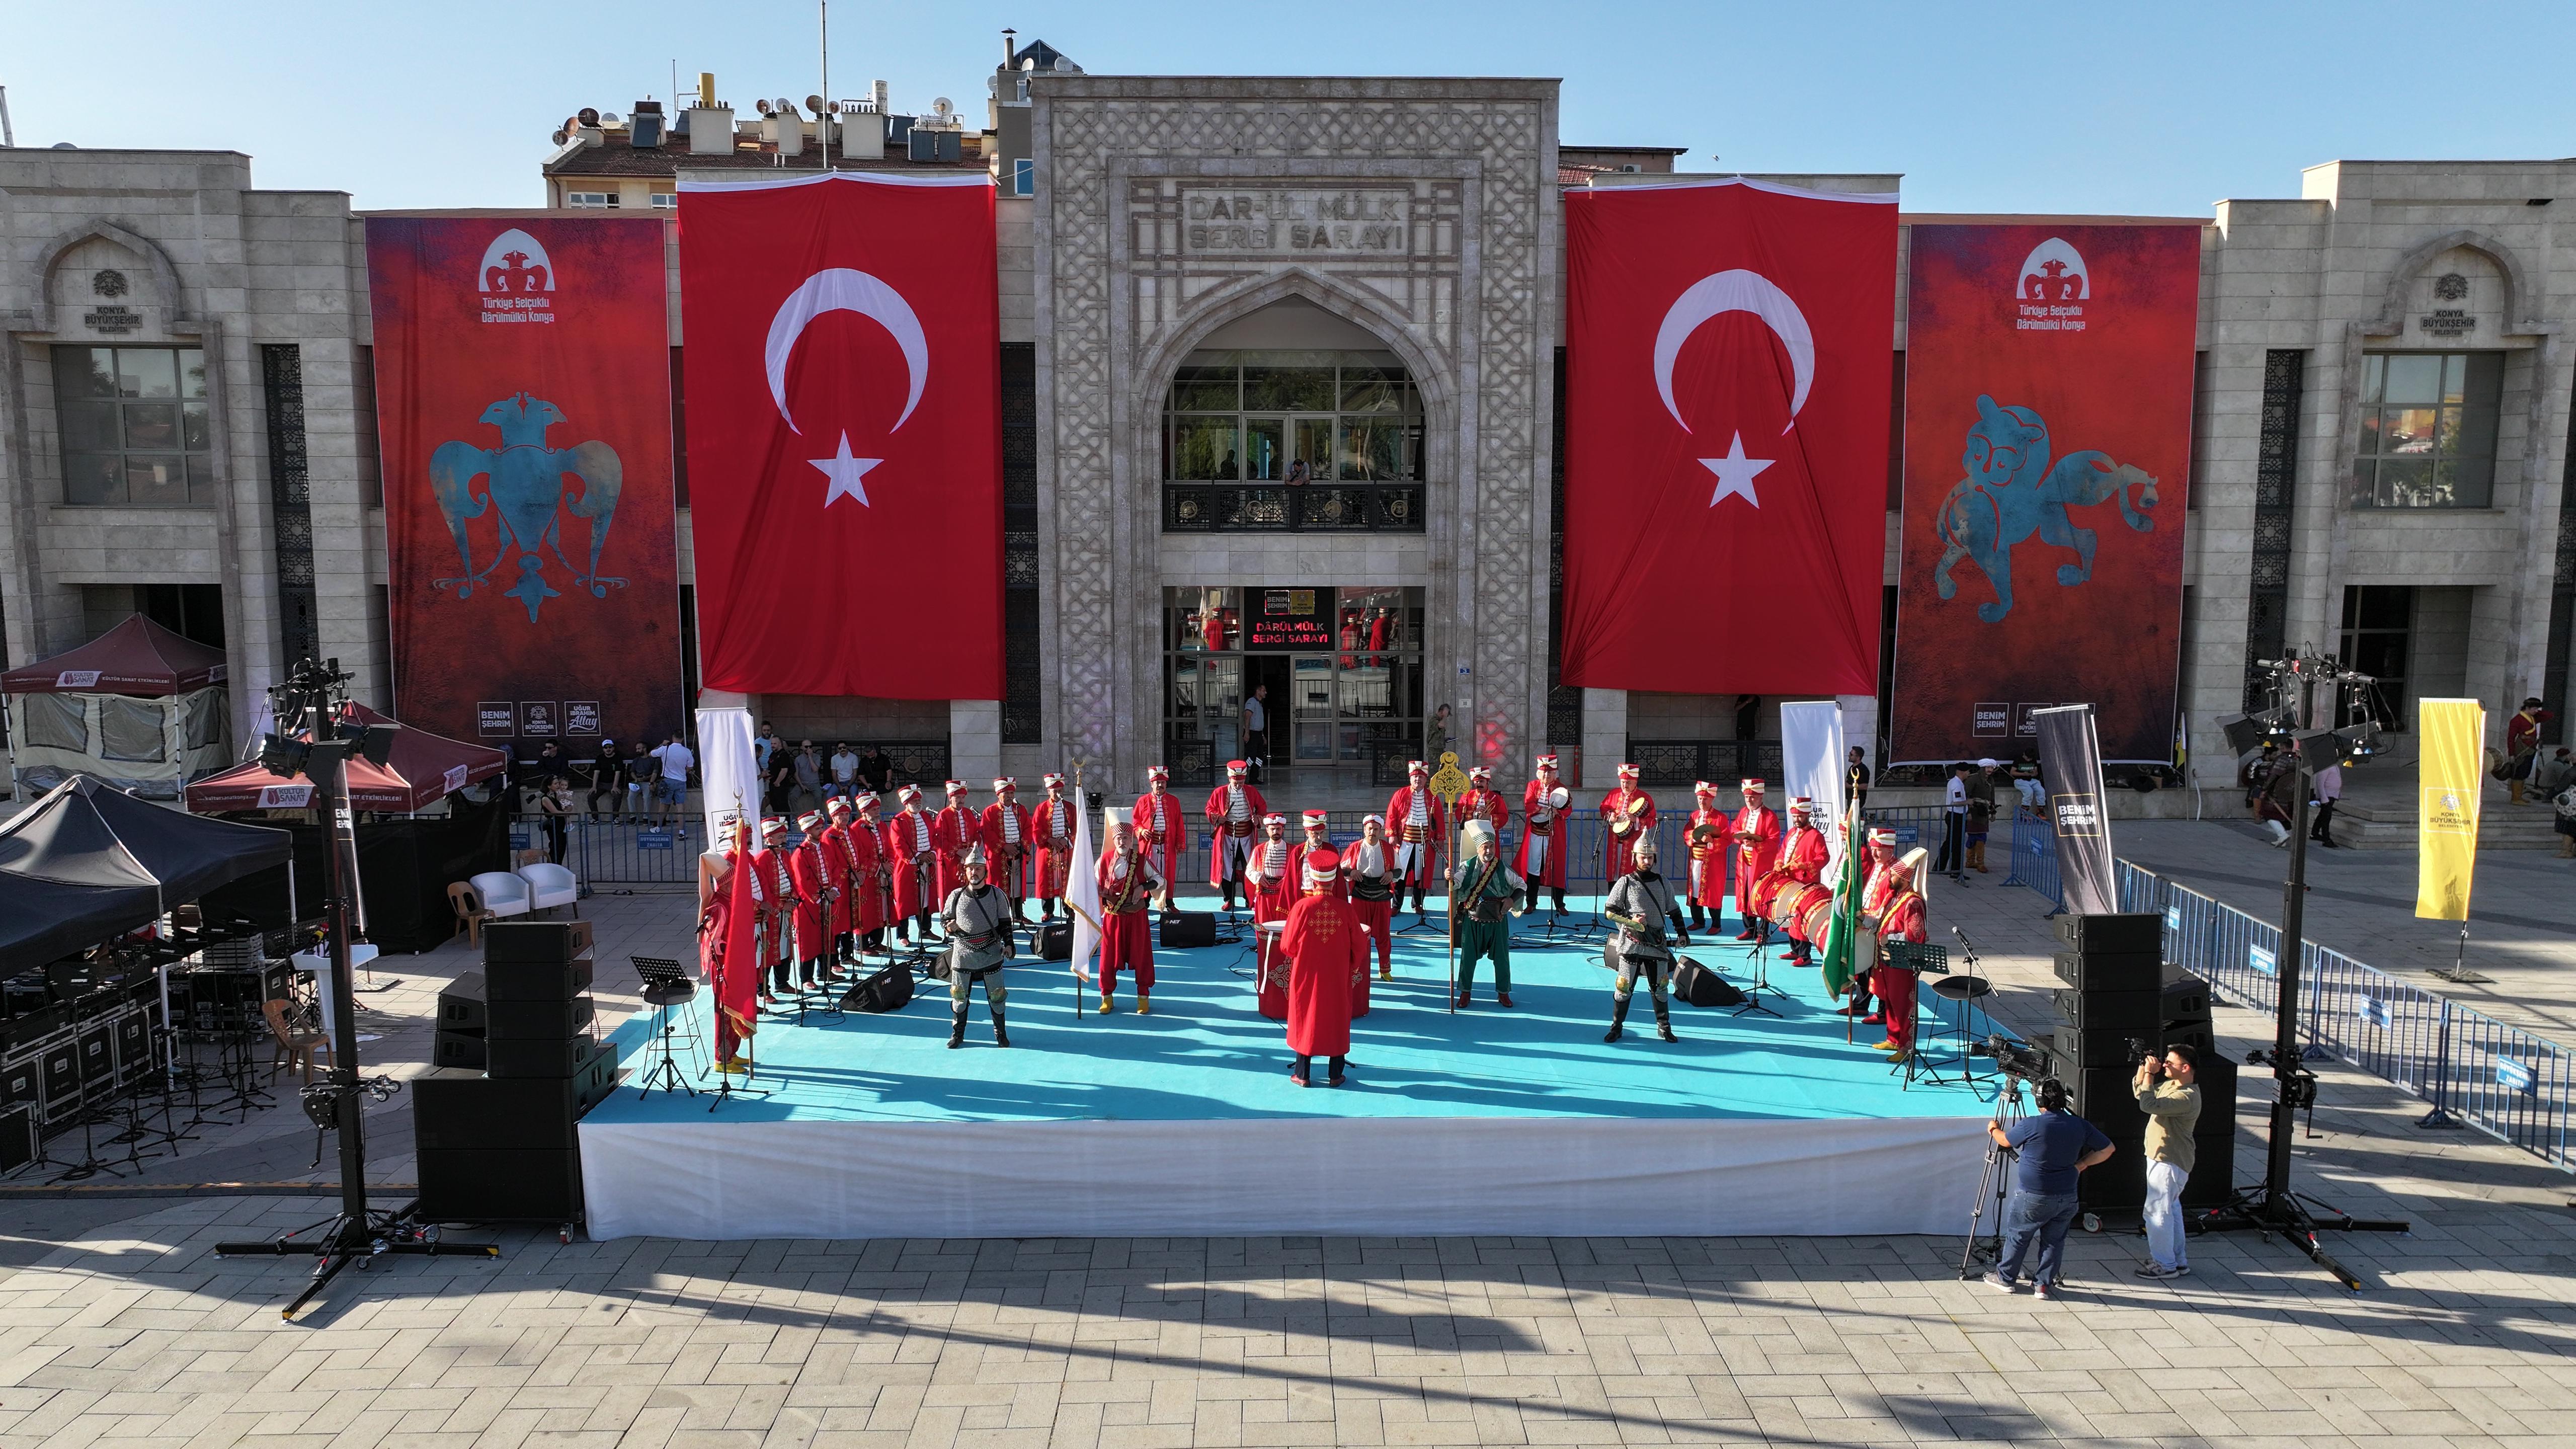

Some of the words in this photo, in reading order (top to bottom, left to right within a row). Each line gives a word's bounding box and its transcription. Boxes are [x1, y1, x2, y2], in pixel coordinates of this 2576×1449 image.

[1318, 194, 1401, 220] MÜLK
[1190, 222, 1276, 249] SERGİ
[1292, 225, 1403, 249] SARAYI
[482, 297, 513, 310] Türkiye
[515, 297, 549, 310] Selçuklu
[2020, 304, 2048, 317] Türkiye
[2050, 305, 2082, 318] Selçuklu
[85, 314, 140, 326] BÜYÜKŞEHİR
[482, 312, 527, 323] Dârülmülkü
[529, 312, 554, 324] Konya
[2017, 318, 2060, 330] Dârülmülkü
[2062, 319, 2085, 331] Konya
[2423, 318, 2475, 329] BÜYÜKŞEHİR
[1256, 621, 1325, 631] DÂRÜLMÜLK
[1252, 632, 1285, 643] SERGİ
[1289, 634, 1328, 643] SARAYI
[569, 715, 597, 730] Altay
